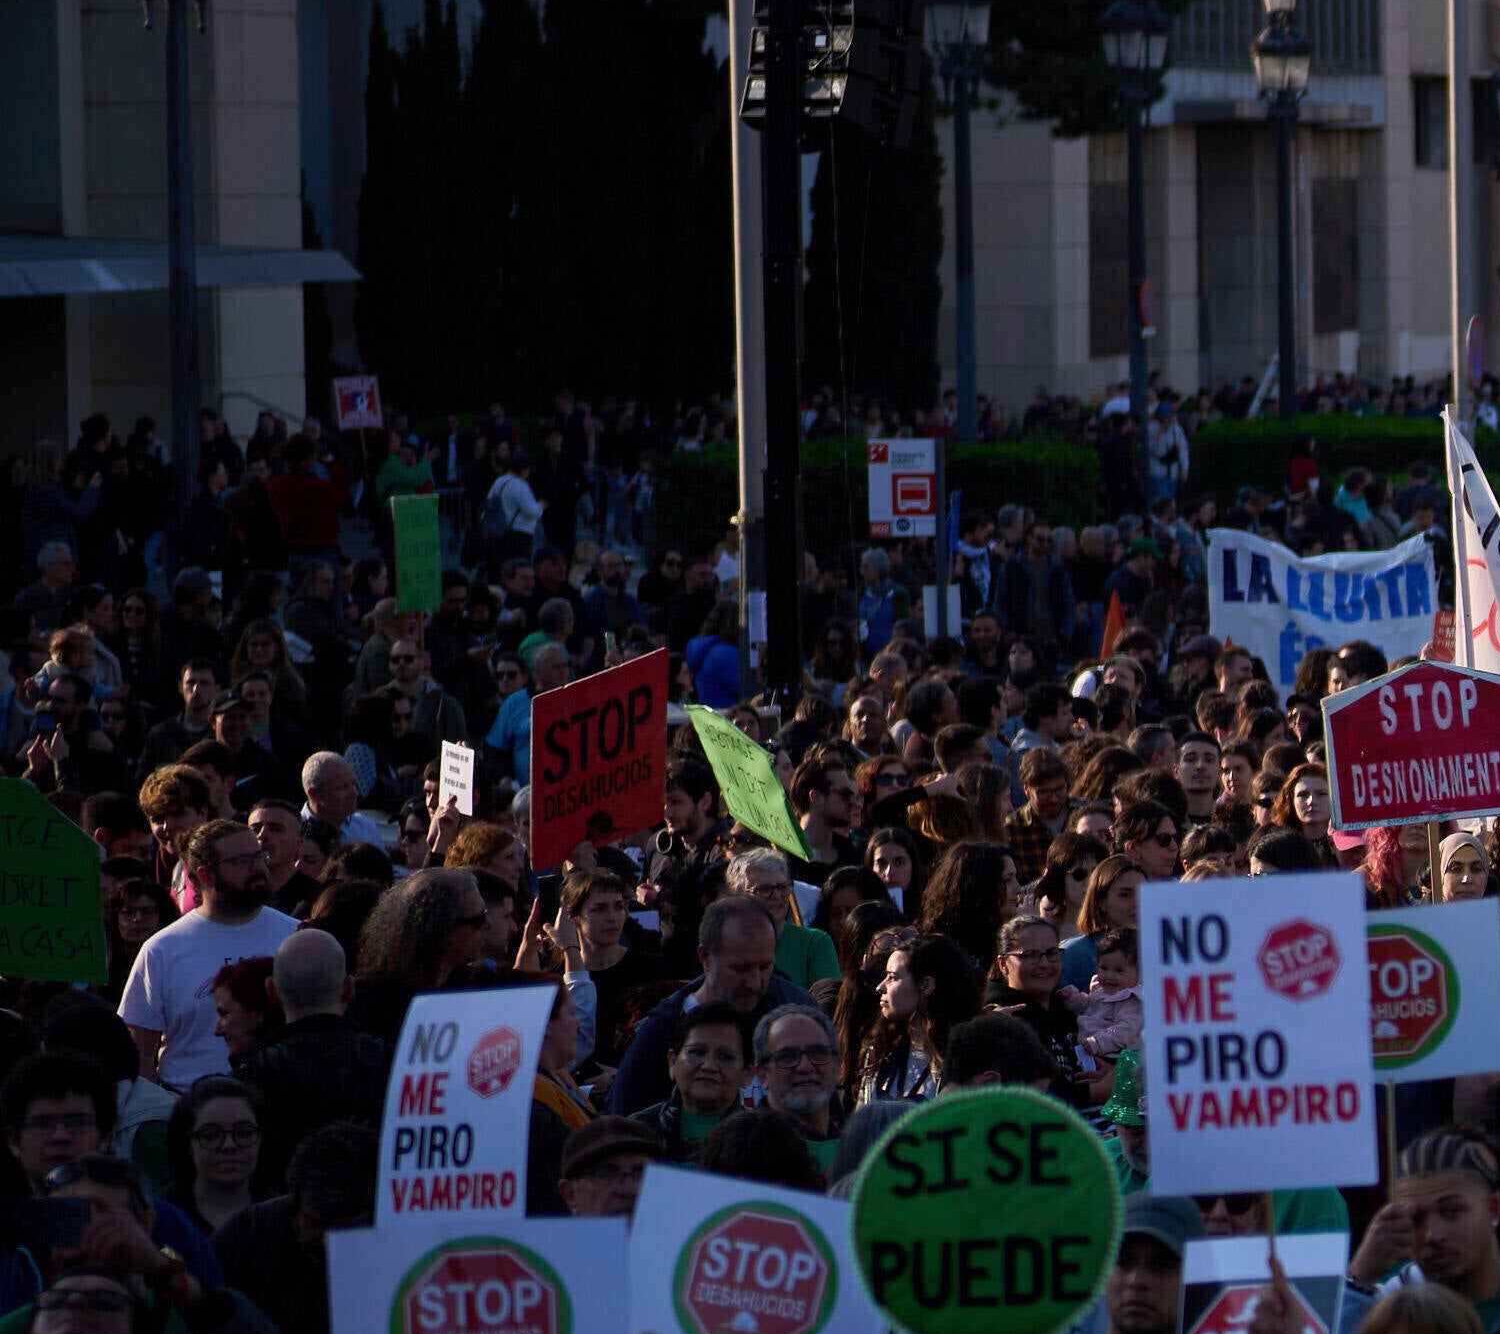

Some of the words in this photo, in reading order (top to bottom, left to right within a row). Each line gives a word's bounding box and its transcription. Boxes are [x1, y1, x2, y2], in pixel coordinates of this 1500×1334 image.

[1222, 548, 1279, 603] LA
[1286, 561, 1432, 622] LLUITA
[1378, 678, 1478, 736] STOP
[545, 683, 653, 784] STOP
[543, 752, 652, 827] DESAHUCIOS
[20, 925, 95, 962] CASA
[1160, 914, 1230, 965] NO
[1264, 933, 1329, 974] STOP
[1163, 974, 1235, 1025] ME
[1367, 957, 1436, 998] TOP
[408, 1022, 459, 1067] NO
[1166, 1030, 1287, 1083] PIRO
[399, 1071, 446, 1117] ME
[1168, 1082, 1360, 1132] VAMPIRO
[393, 1123, 474, 1171] PIRO
[886, 1127, 971, 1199] SI
[986, 1121, 1071, 1188] SE
[390, 1172, 518, 1214] VAMPIRO
[703, 1237, 818, 1295] STOP
[870, 1235, 1093, 1310] PUEDE
[416, 1279, 545, 1330] STOP
[696, 1280, 808, 1321] DESAHUCIOS
